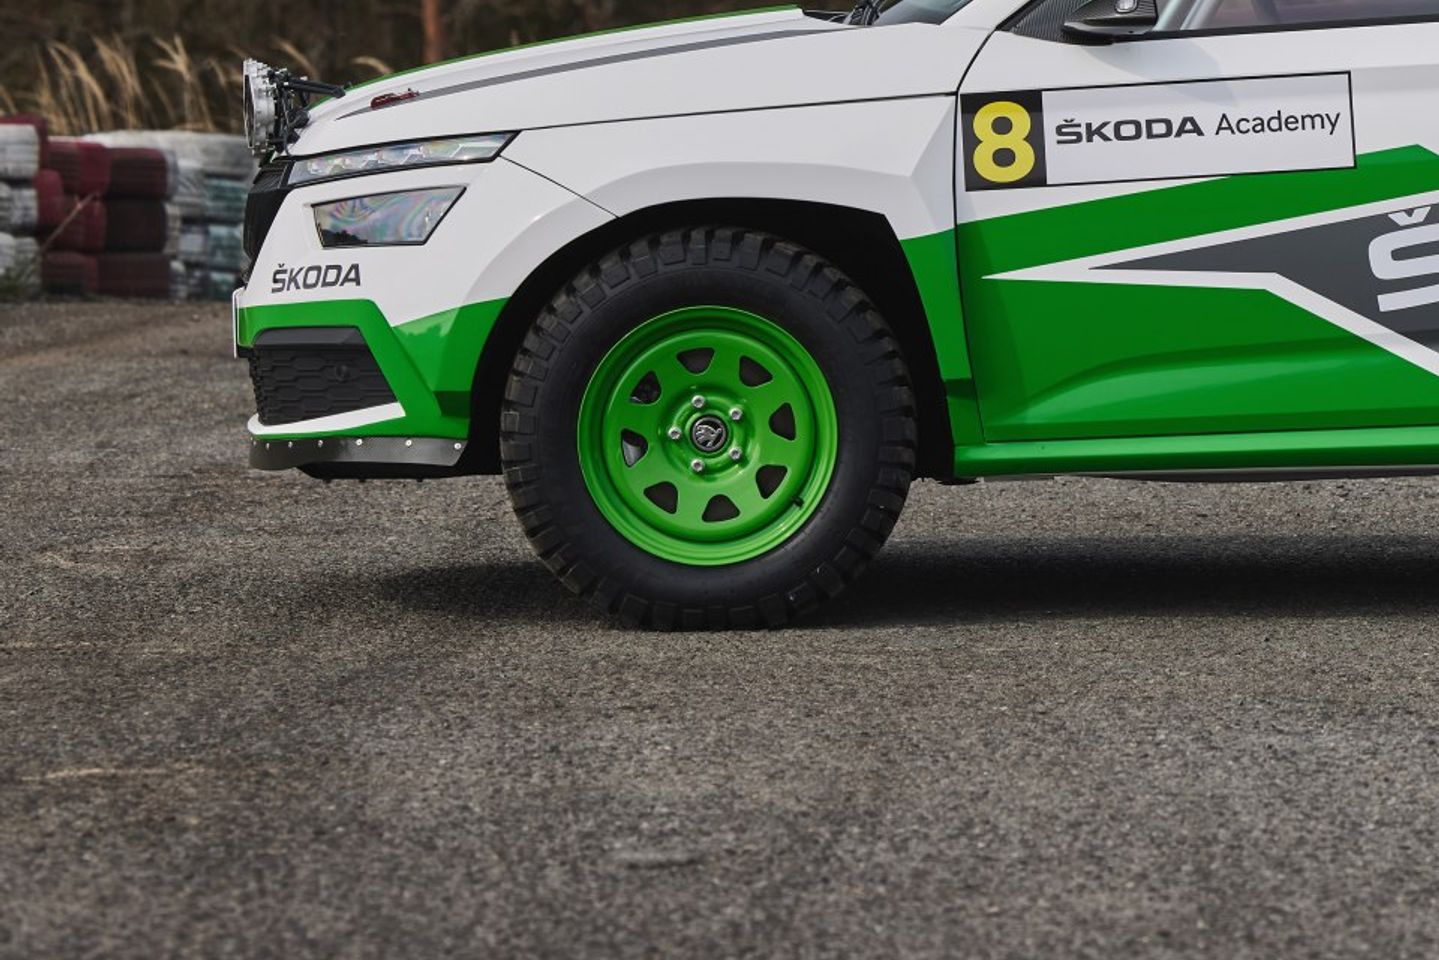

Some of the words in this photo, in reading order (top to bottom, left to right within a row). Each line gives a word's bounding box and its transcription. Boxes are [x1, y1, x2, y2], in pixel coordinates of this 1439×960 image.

[972, 100, 1036, 184] 8
[1055, 116, 1205, 145] ŠKODA
[1214, 109, 1341, 136] Academy
[271, 262, 361, 294] ŠKODA
